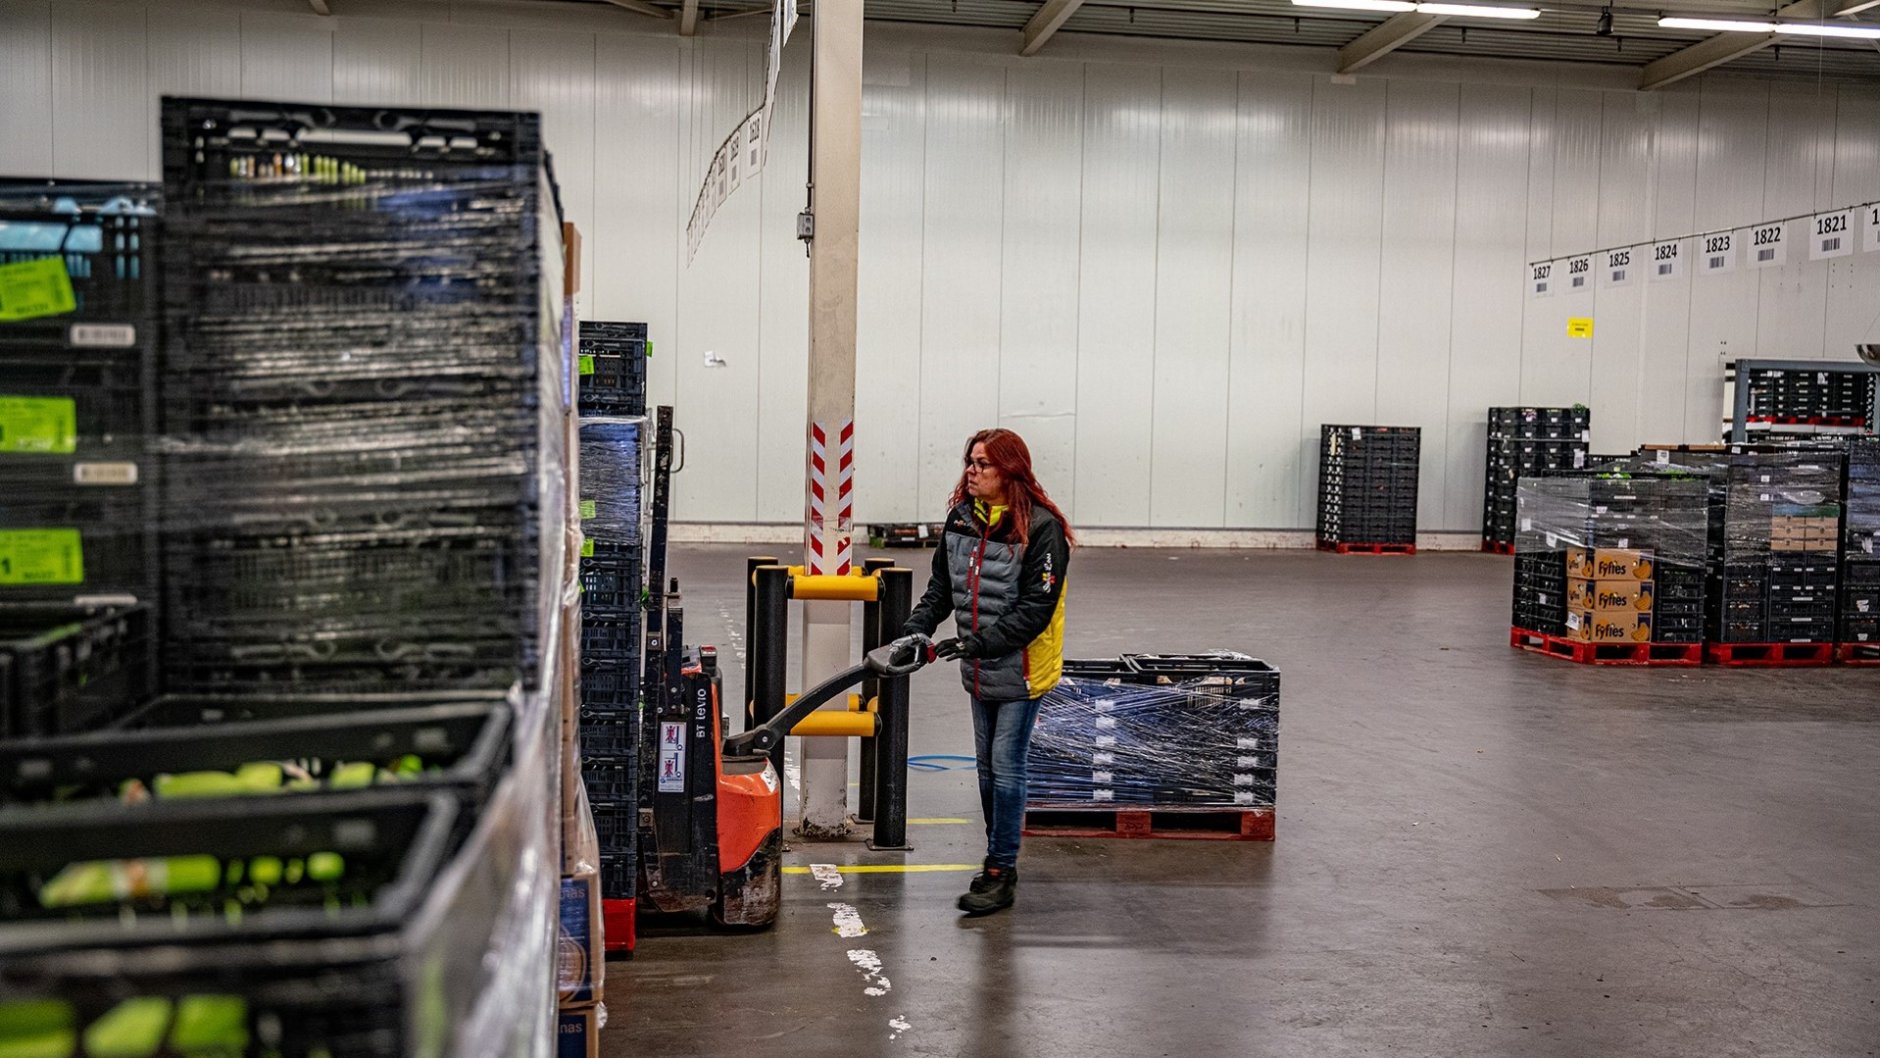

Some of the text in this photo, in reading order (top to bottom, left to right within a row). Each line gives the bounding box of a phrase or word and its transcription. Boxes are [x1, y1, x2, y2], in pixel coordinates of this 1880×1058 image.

[1816, 214, 1847, 235] 1821
[1753, 226, 1781, 245] 1822
[1654, 244, 1678, 260] 1824
[1705, 236, 1731, 253] 1823
[1569, 258, 1589, 274] 1826
[1609, 251, 1630, 268] 1825
[1533, 266, 1551, 280] 1827
[695, 724, 706, 738] BT
